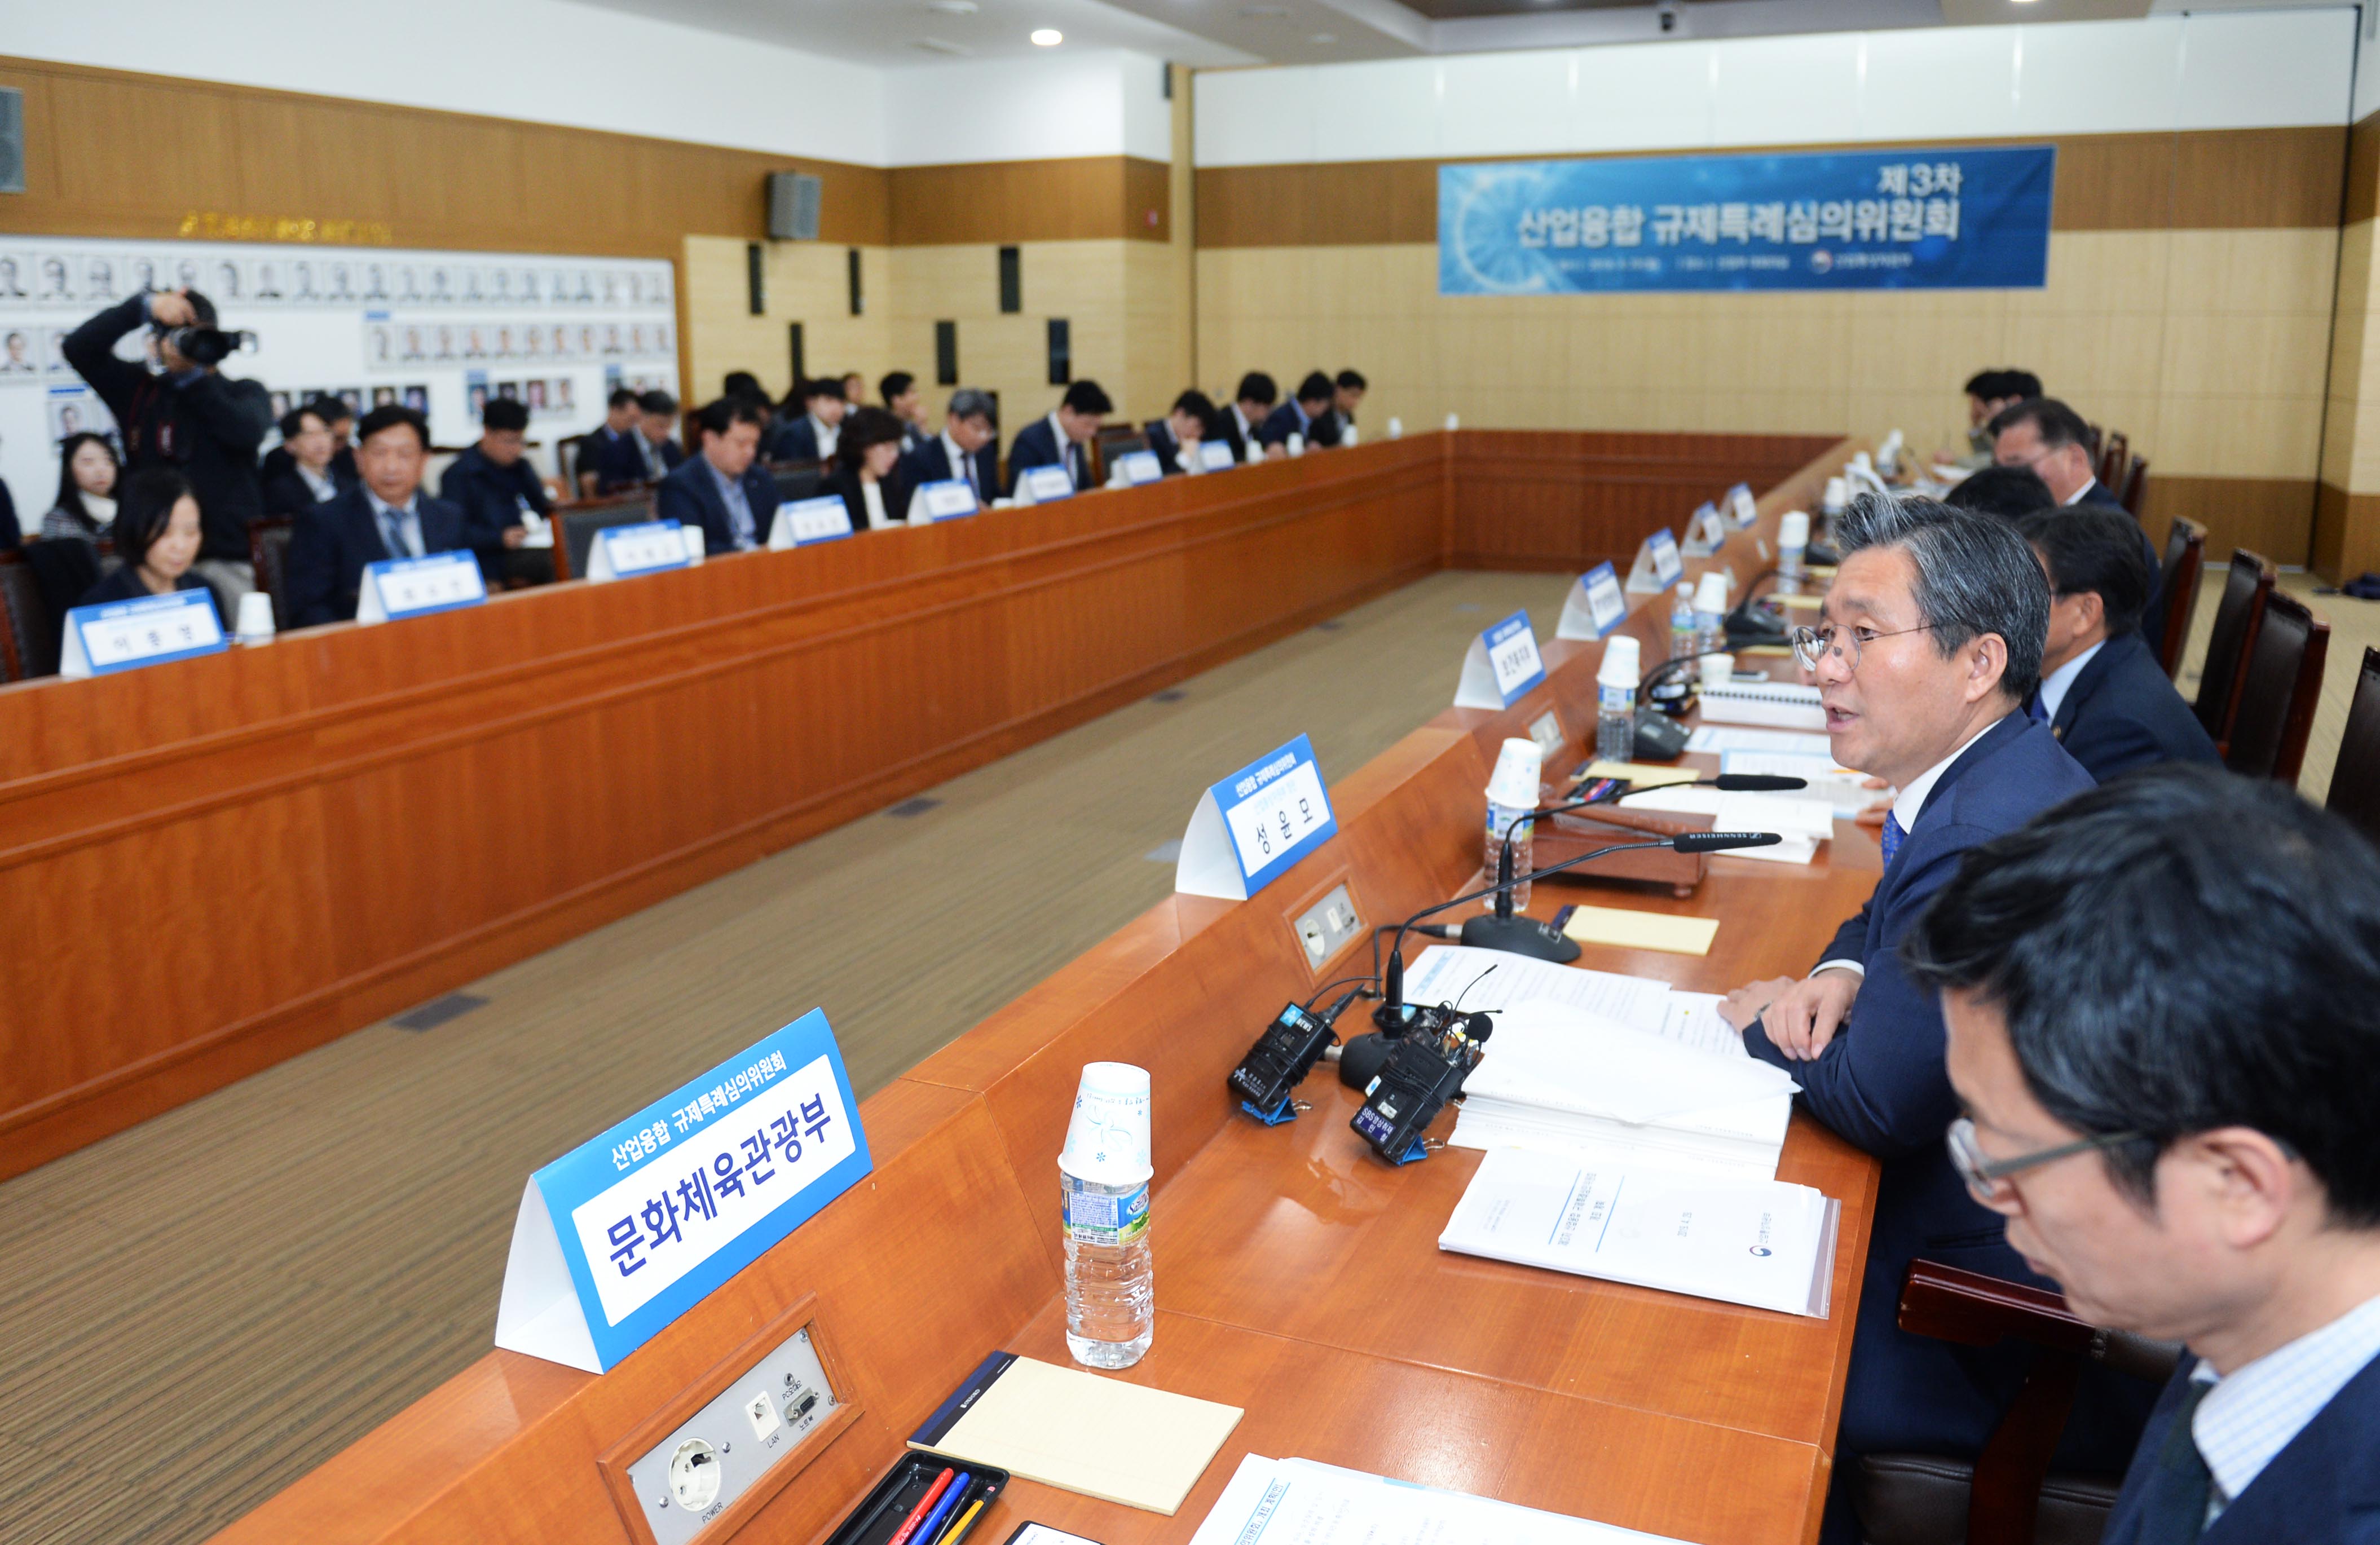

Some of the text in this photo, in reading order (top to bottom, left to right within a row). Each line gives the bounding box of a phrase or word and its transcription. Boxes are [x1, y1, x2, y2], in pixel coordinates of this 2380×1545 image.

[1877, 163, 1963, 198] 제3차
[1515, 204, 1645, 248] 산업융합
[1297, 1018, 1313, 1032] NEWS
[611, 1049, 787, 1171] 산업융합 규제특례심의위원회
[606, 1092, 831, 1278] 문화체육관광부
[782, 1380, 802, 1401] PC오디오
[799, 1414, 813, 1431] 노트북
[767, 1434, 780, 1449] LAN
[702, 1502, 724, 1524] POWER
